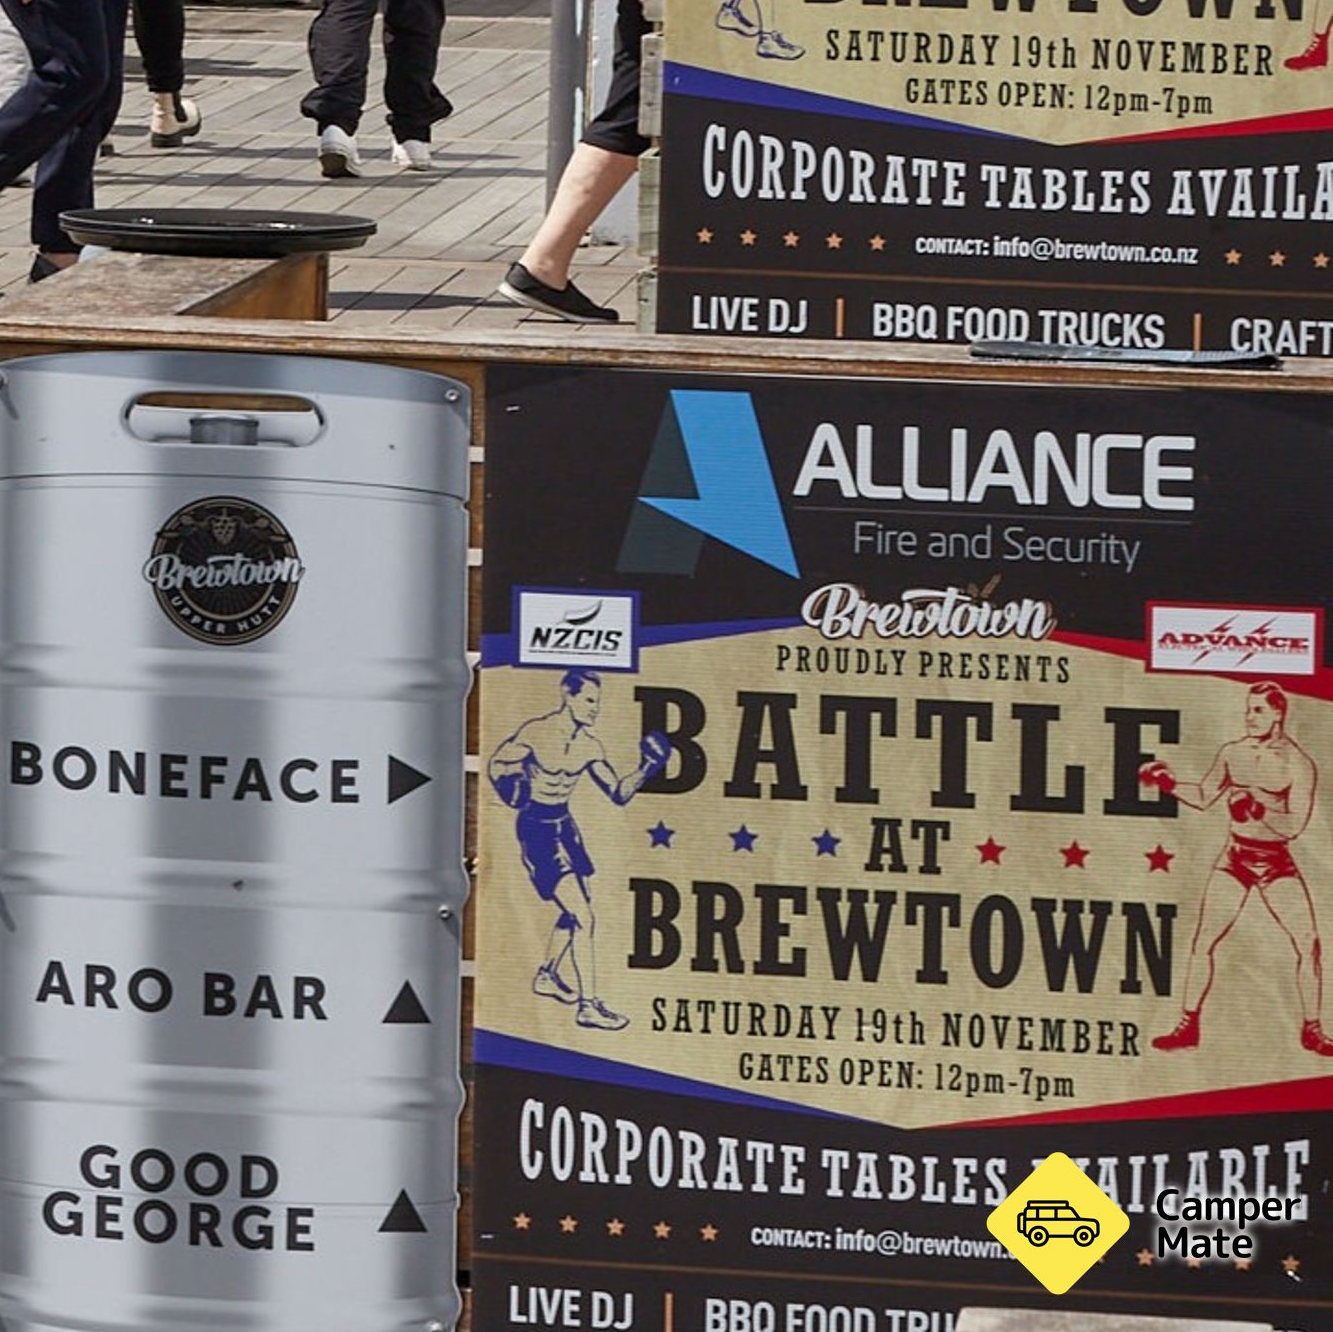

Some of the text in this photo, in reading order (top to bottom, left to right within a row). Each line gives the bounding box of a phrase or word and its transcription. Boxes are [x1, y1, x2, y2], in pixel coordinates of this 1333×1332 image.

[825, 28, 1275, 78] SATURDAY 19th NOVEMBER
[906, 77, 1214, 120] GATES OPEN: 12pm-7pm
[701, 122, 968, 208] CORPORATE
[979, 163, 1153, 217] TABLES
[914, 234, 1199, 266] CONTACT: info@brewtown.co.nz
[692, 294, 809, 334] LIVE DJ
[872, 302, 1166, 349] BBQ FOOD TRUCKS
[793, 422, 1196, 511] ALLIANCE
[144, 551, 306, 591] Brewtown
[854, 521, 1141, 573] Fire and Security
[171, 594, 281, 634] UPPER HUTT
[801, 580, 1056, 641] Brewtown
[530, 626, 623, 651] NZCIS
[776, 643, 1071, 683] PROUDLY PRESENTS
[1158, 632, 1309, 650] ADVANCE
[10, 740, 361, 804] BONEFACE
[633, 684, 1181, 818] BATTLE
[863, 817, 952, 875] AT
[627, 876, 1178, 997] BREWTOWN
[36, 960, 328, 1022] ARO BAR
[651, 996, 1141, 1058] SATURDAY 19th NOVEMBER
[738, 1050, 1076, 1103] GATES OPEN: 12pm-7pm
[79, 1144, 279, 1200] GOOD
[519, 1097, 1310, 1221] CORPORATE TABLES AILABLE
[42, 1190, 315, 1252] GEORGE
[751, 1227, 1016, 1260] CONTACT: info@brewtown.
[509, 1284, 634, 1330] LIVE DJ
[785, 1301, 876, 1332] FOOD
[885, 1308, 957, 1332] TRU
